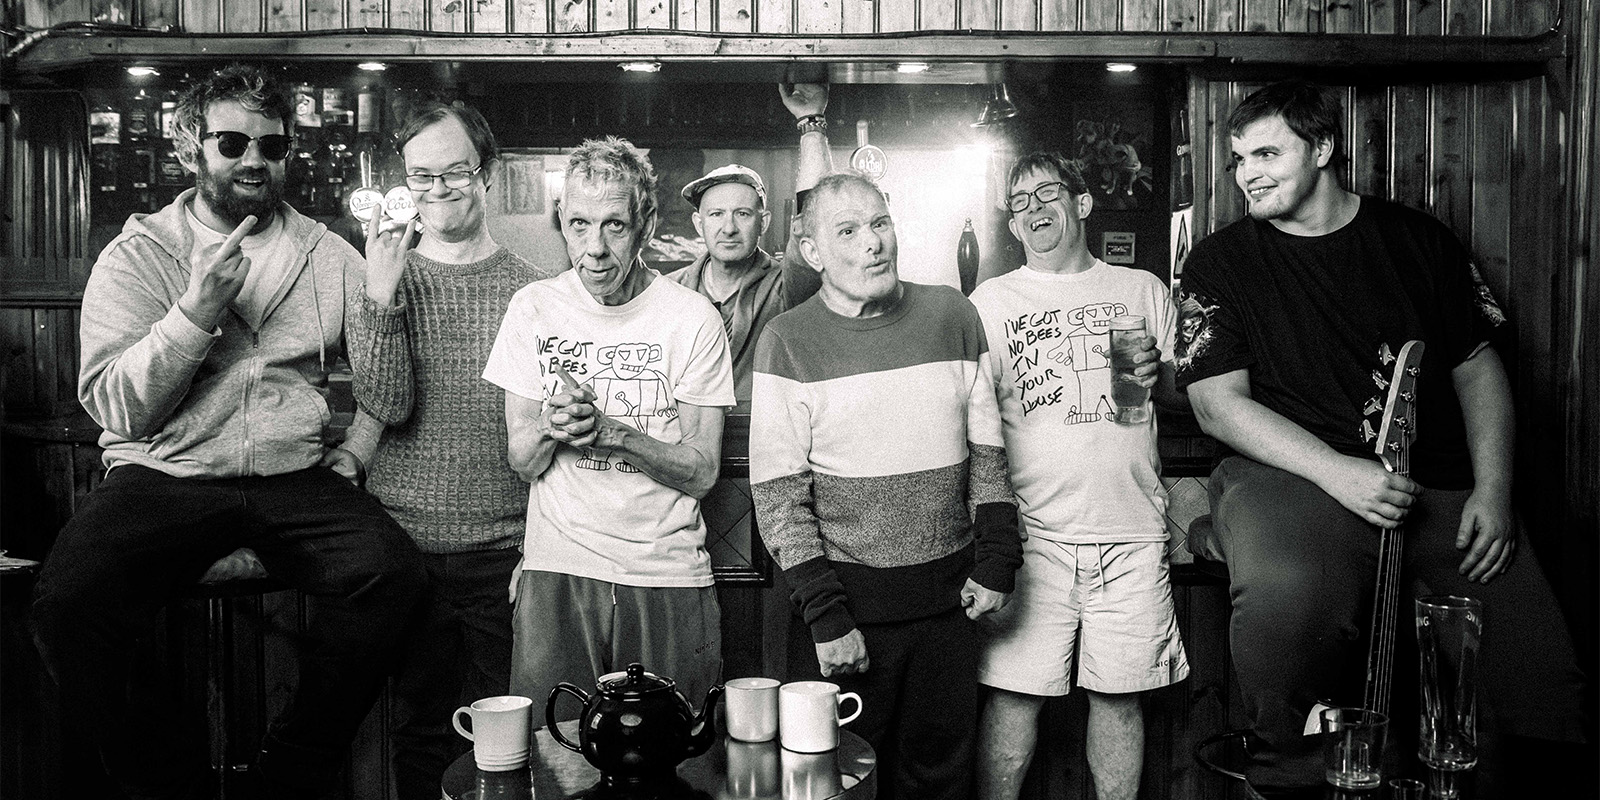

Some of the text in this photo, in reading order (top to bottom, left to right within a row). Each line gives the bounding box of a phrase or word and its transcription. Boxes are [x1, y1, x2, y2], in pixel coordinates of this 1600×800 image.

[1004, 309, 1062, 339] I'VE GOT
[558, 339, 594, 359] GOT
[1008, 327, 1062, 359] NO BEES
[548, 356, 588, 375] BEES
[1012, 349, 1039, 383] IN
[1017, 368, 1062, 401] YOUR
[1022, 386, 1063, 417] HOUSE
